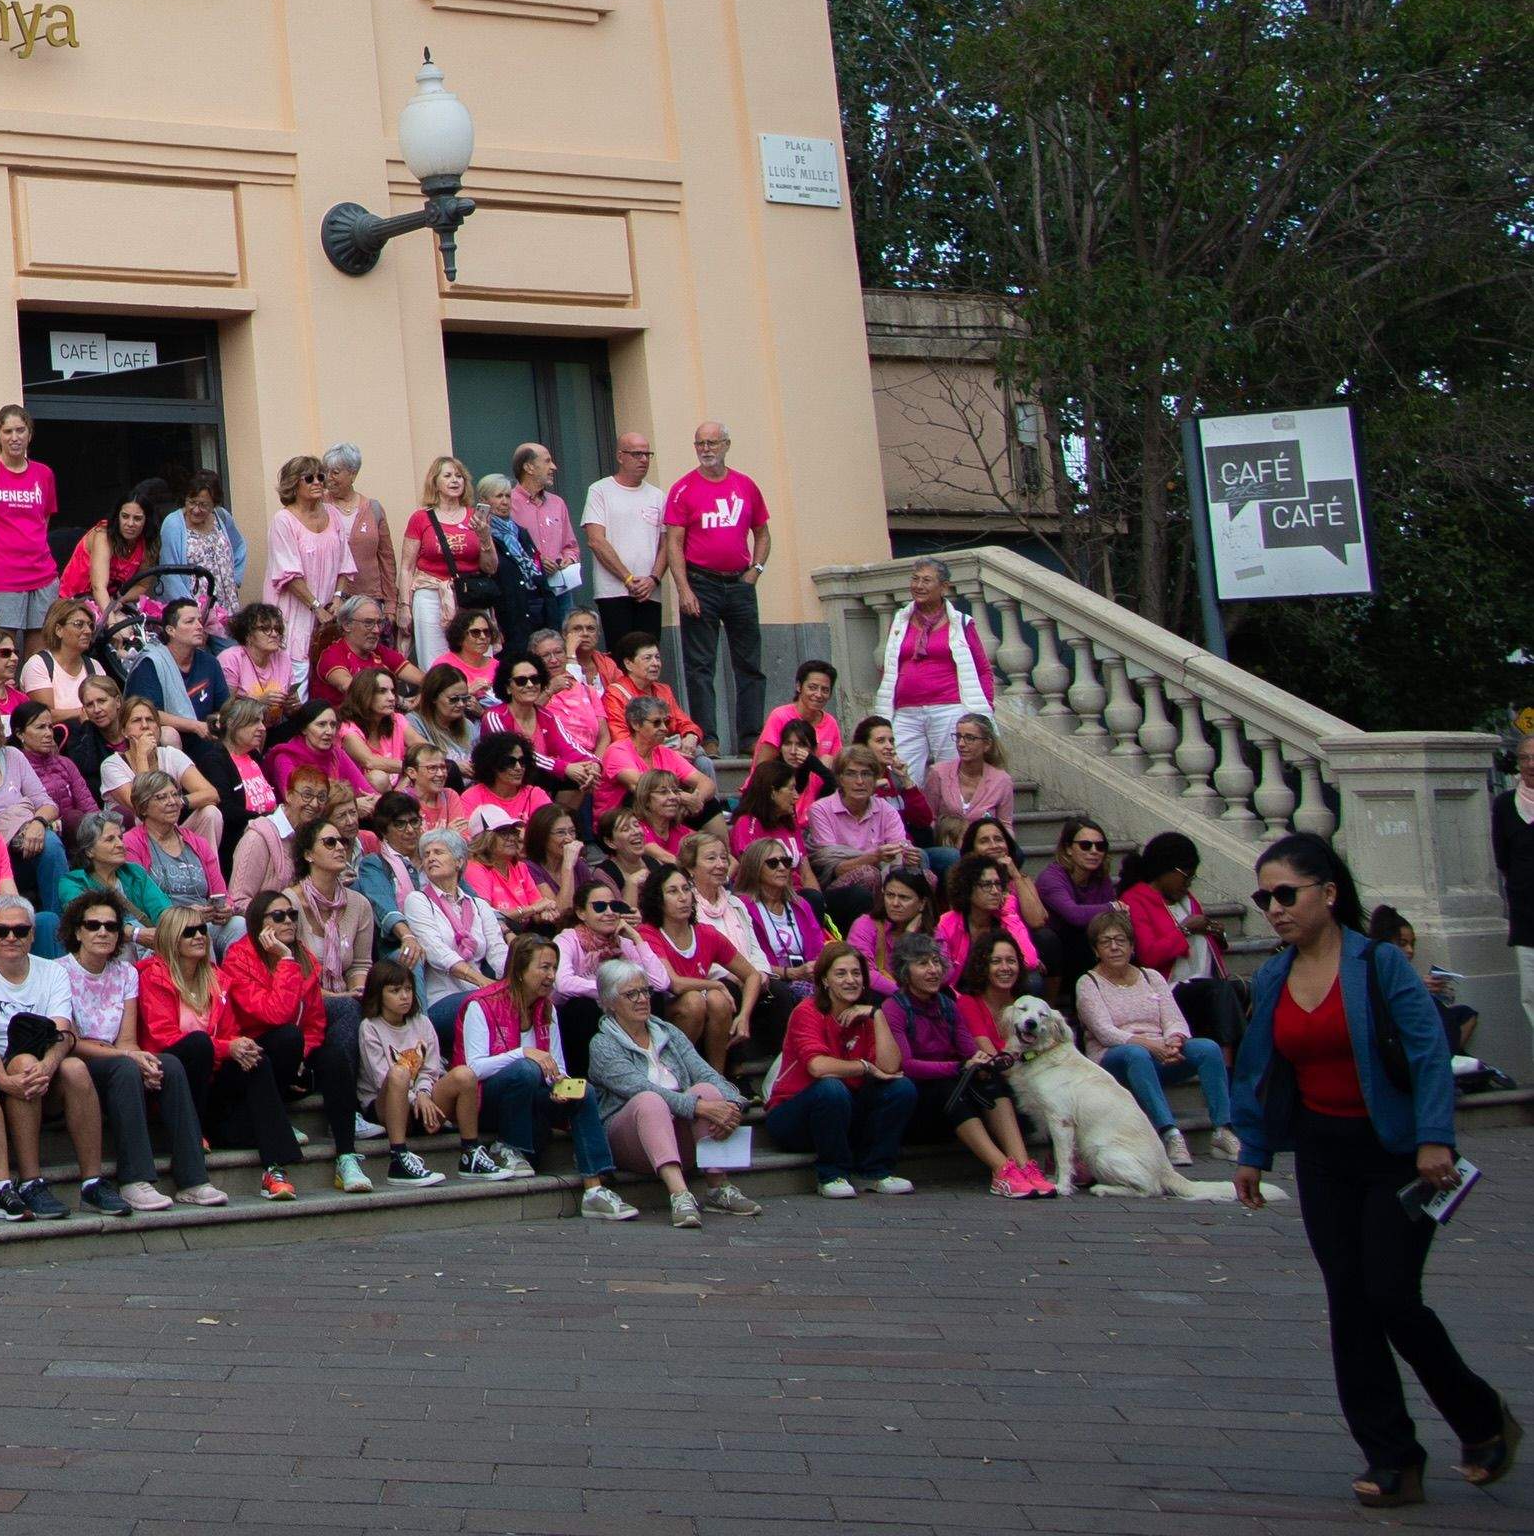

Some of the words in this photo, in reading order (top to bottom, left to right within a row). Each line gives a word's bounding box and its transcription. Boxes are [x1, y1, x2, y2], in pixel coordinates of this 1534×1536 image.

[795, 155, 806, 164] DE
[799, 168, 834, 182] MILLET
[59, 340, 98, 360] CAFÉ
[113, 349, 151, 368] CAFÉ
[1220, 451, 1292, 485] CAFÉ
[1272, 495, 1345, 529] CAFÉ
